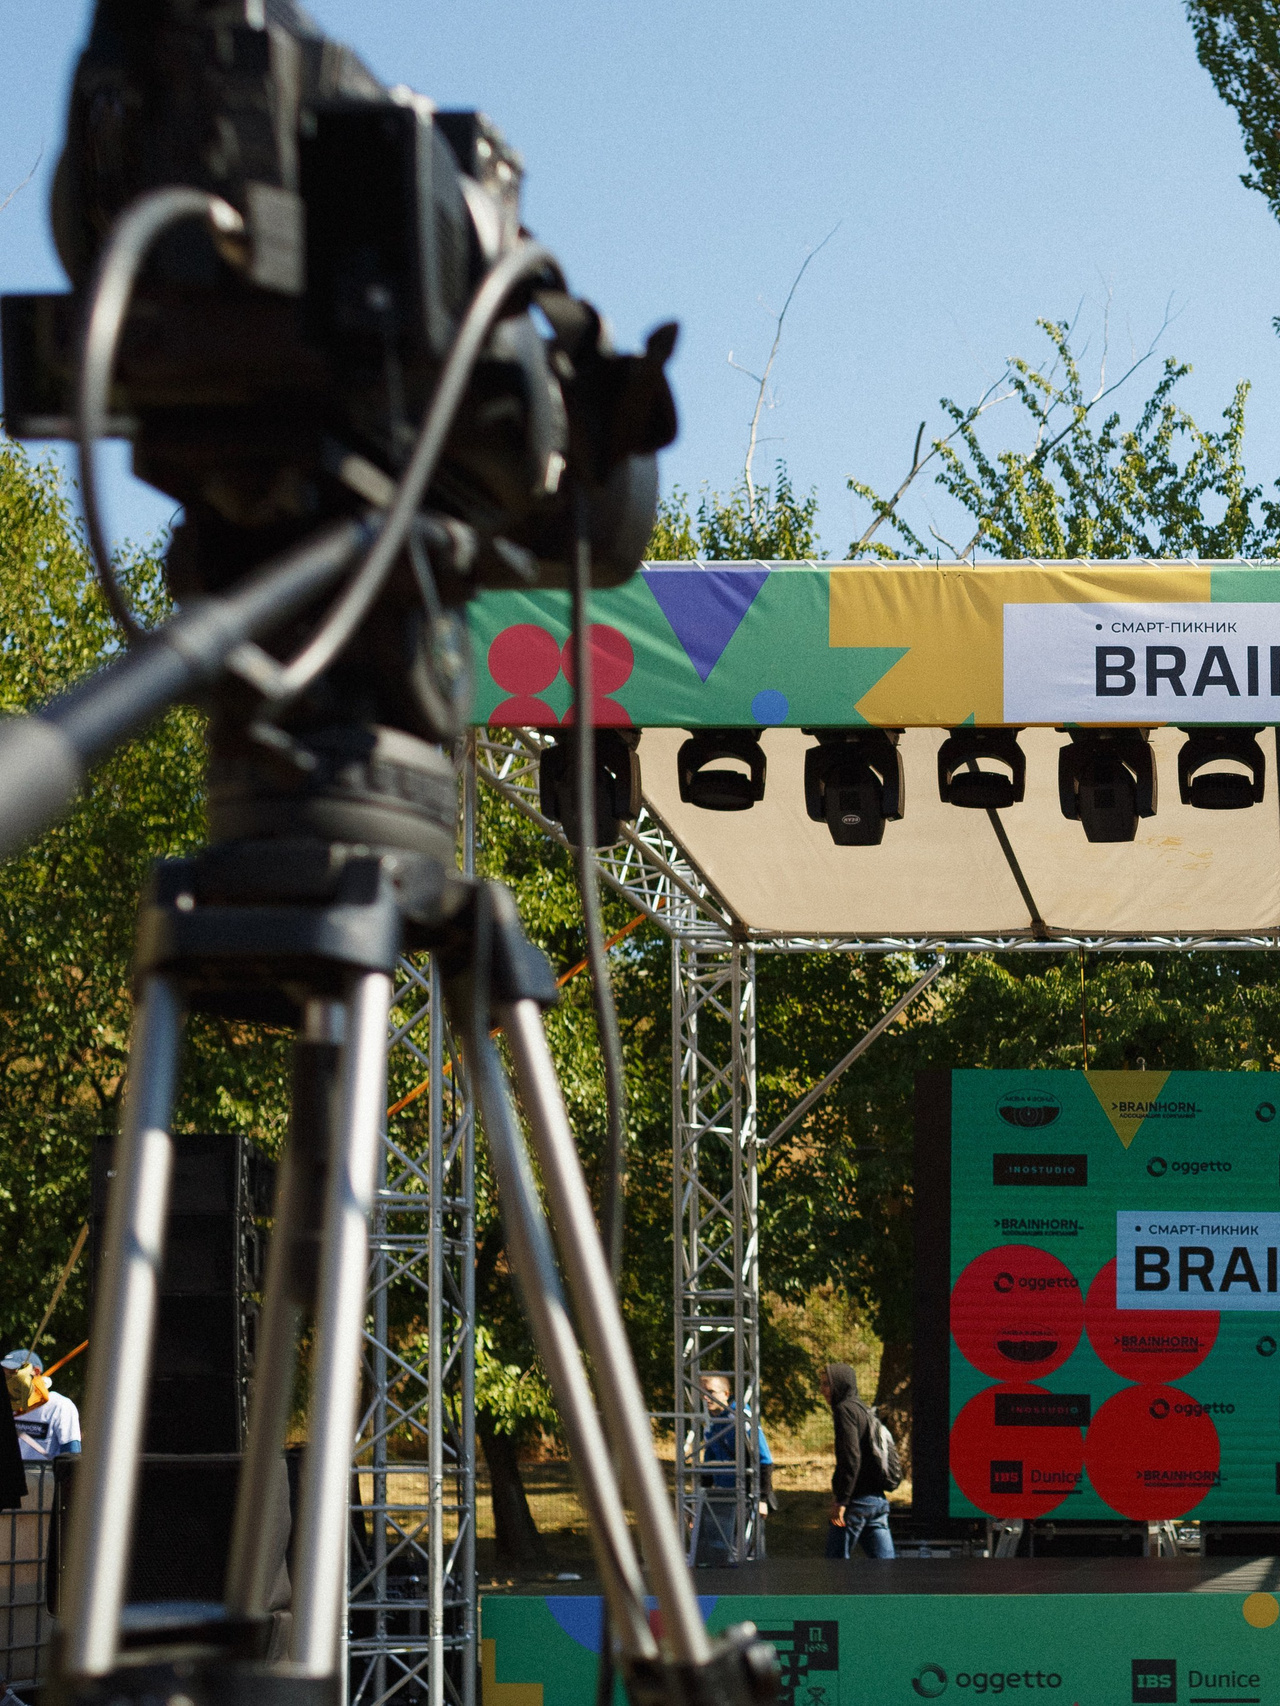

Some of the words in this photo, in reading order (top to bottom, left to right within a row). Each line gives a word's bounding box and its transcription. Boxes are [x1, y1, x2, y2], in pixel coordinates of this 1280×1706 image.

[1111, 622, 1237, 634] СМАРТ-ПИКНИК
[1171, 1160, 1232, 1174] oggetto
[1148, 1224, 1259, 1236] СМАРТ-ПИКНИК
[1018, 1277, 1079, 1290] oggetto
[1174, 1402, 1235, 1417] oggetto
[1031, 1470, 1082, 1483] Dunice
[956, 1670, 1062, 1693] oggetto
[1137, 1675, 1172, 1688] IBS
[1189, 1671, 1260, 1688] Dunice
